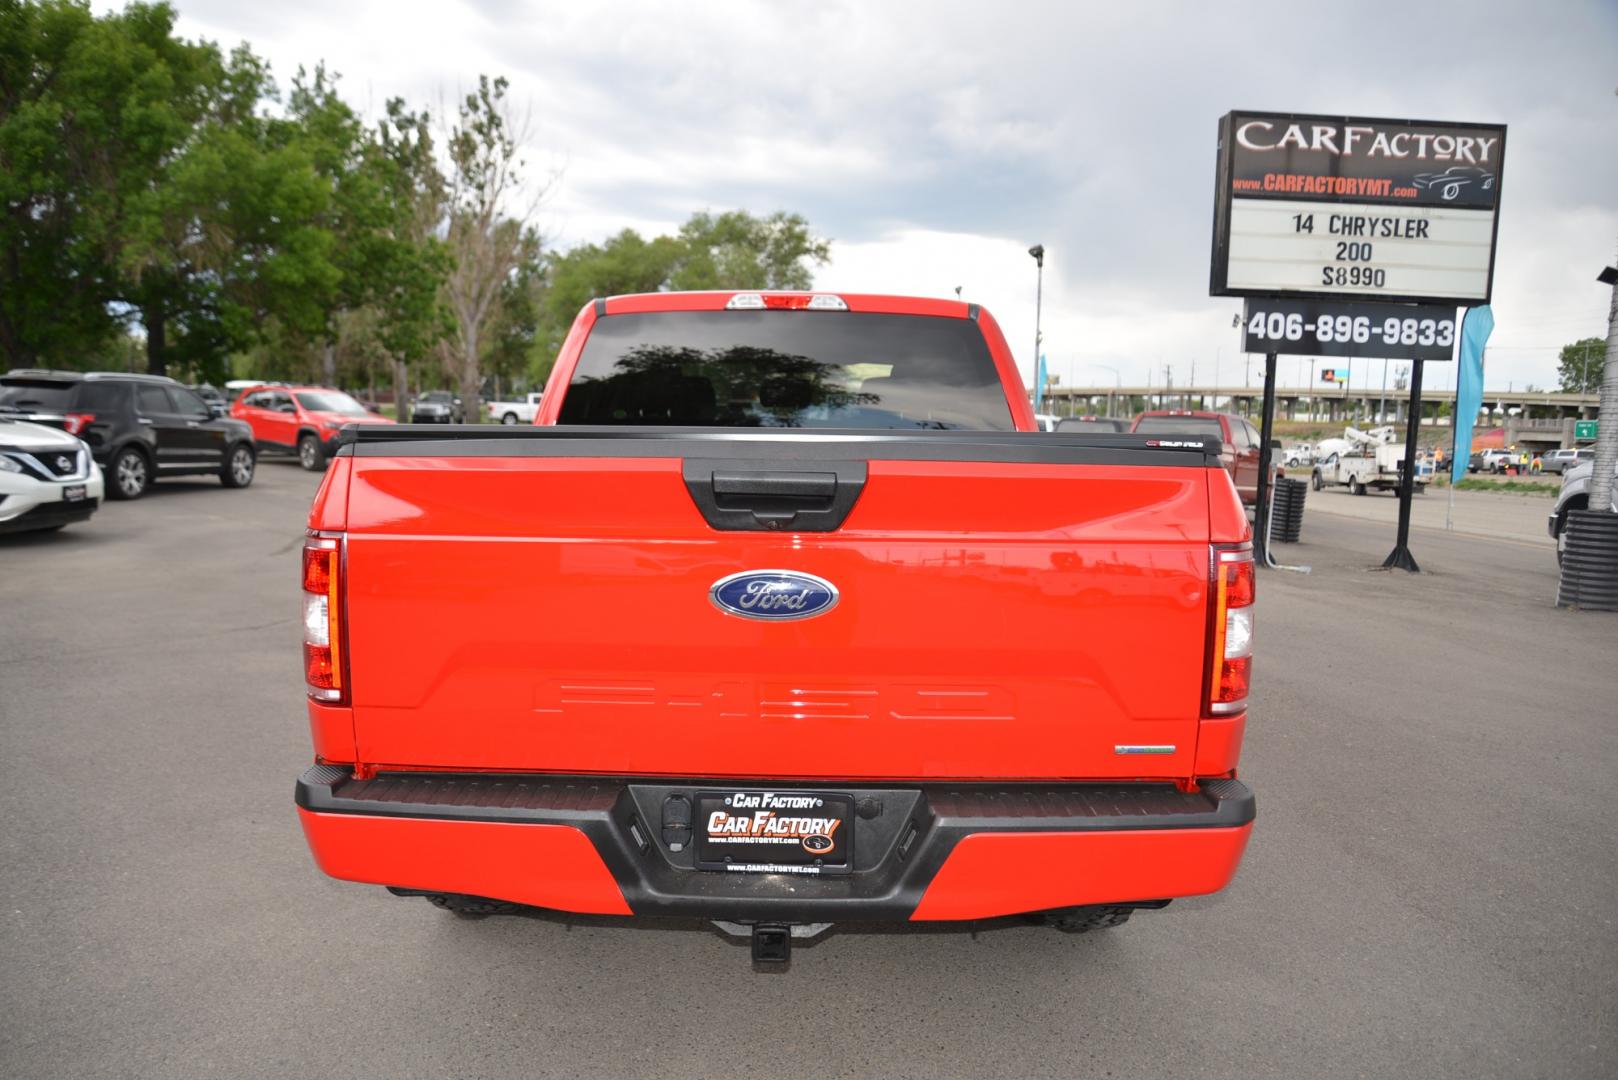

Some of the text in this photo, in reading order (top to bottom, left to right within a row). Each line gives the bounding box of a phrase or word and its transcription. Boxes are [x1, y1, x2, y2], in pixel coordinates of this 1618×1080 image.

[1232, 173, 1418, 198] www.CARFACTORYMT.com
[1292, 214, 1430, 239] 14 CHRYSLER
[1335, 242, 1373, 262] 200
[1248, 311, 1454, 347] 406-896-9833
[739, 580, 813, 610] Ford
